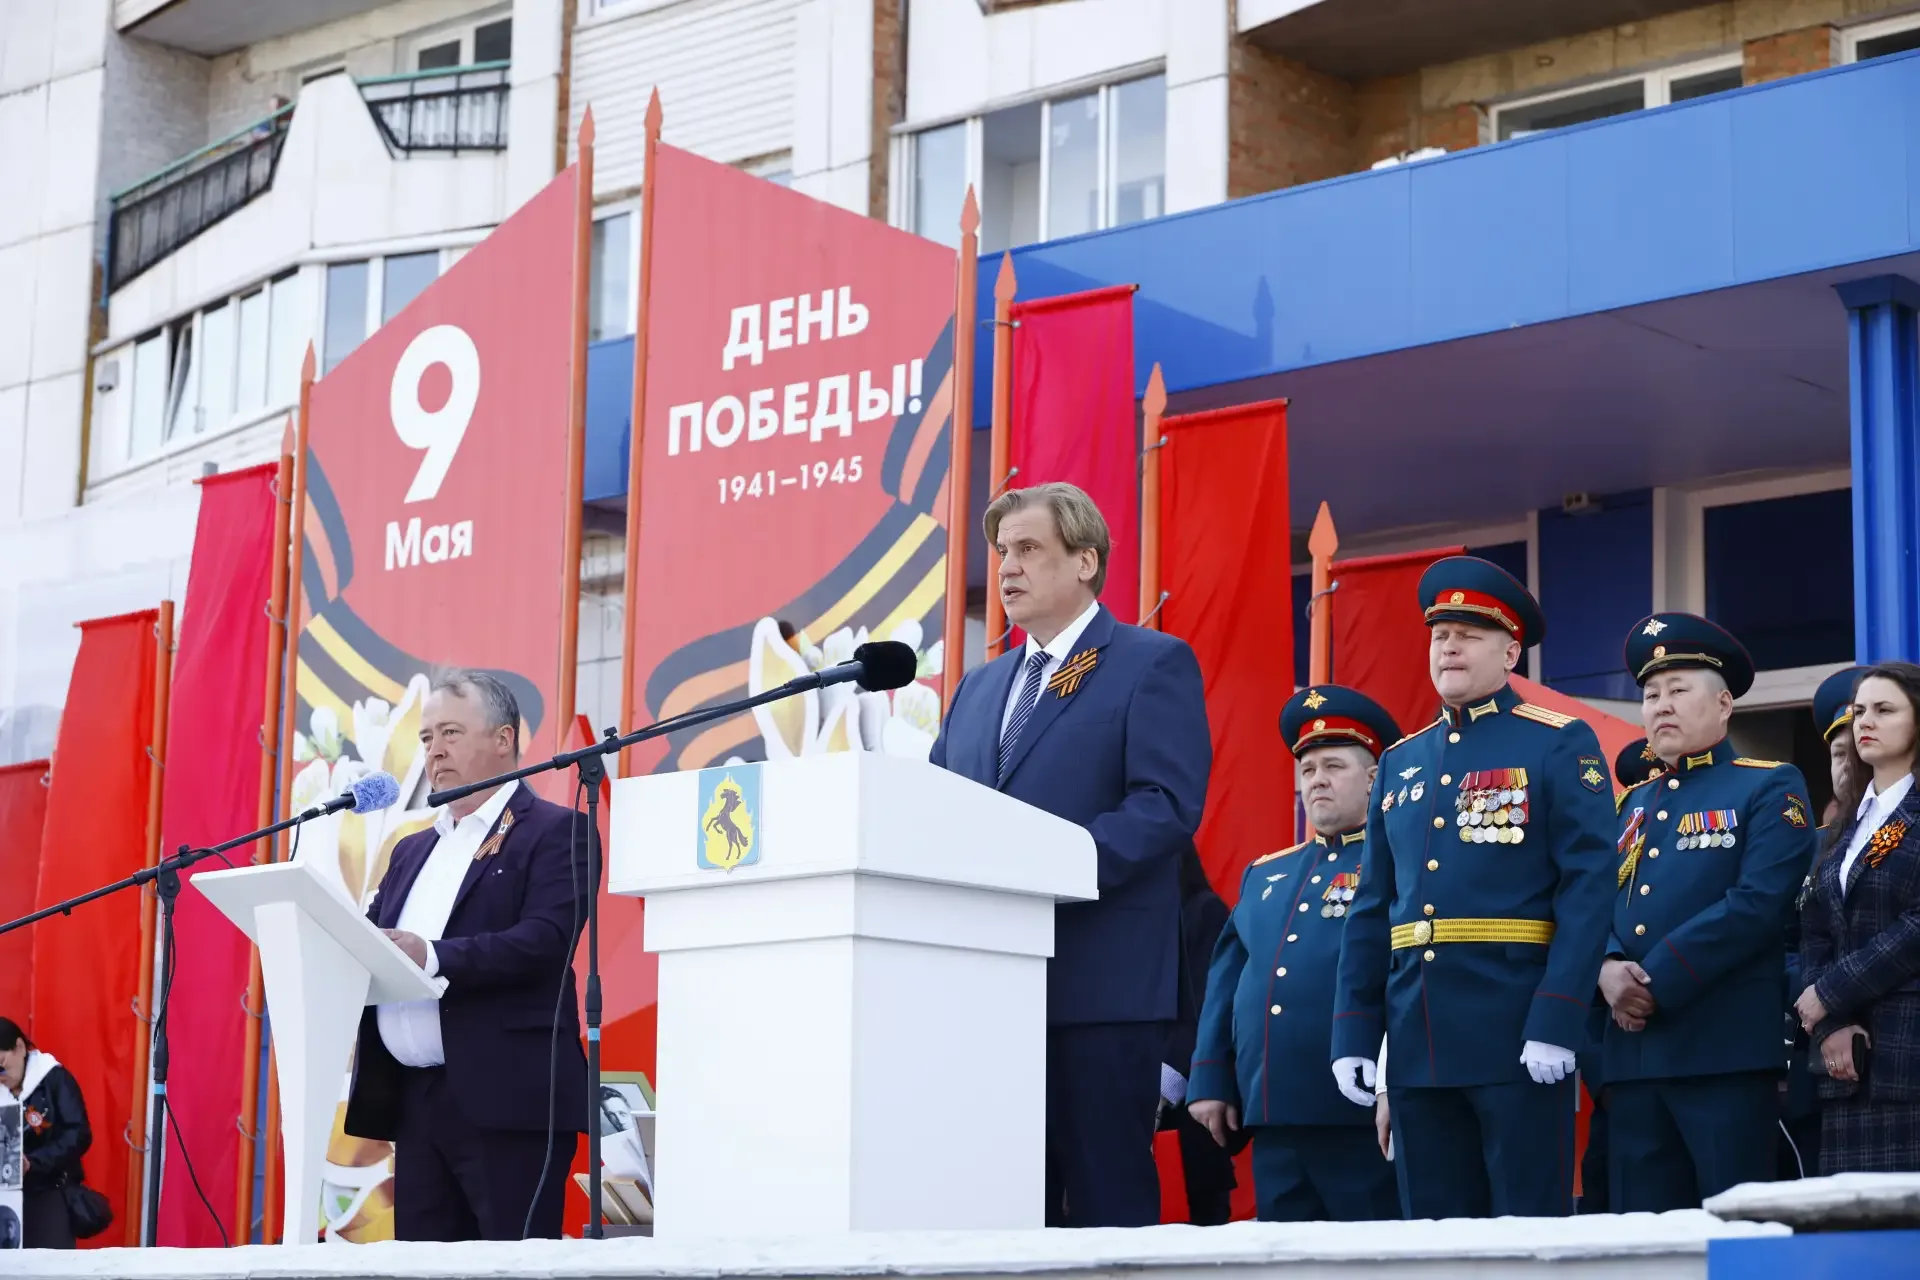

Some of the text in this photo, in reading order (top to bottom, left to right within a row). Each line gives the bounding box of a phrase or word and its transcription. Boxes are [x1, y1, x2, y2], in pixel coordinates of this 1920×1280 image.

[723, 286, 868, 370] ДЕНЬ
[391, 325, 480, 503] 9
[668, 358, 923, 456] ПОБЕДЫ!
[385, 517, 473, 571] Мая
